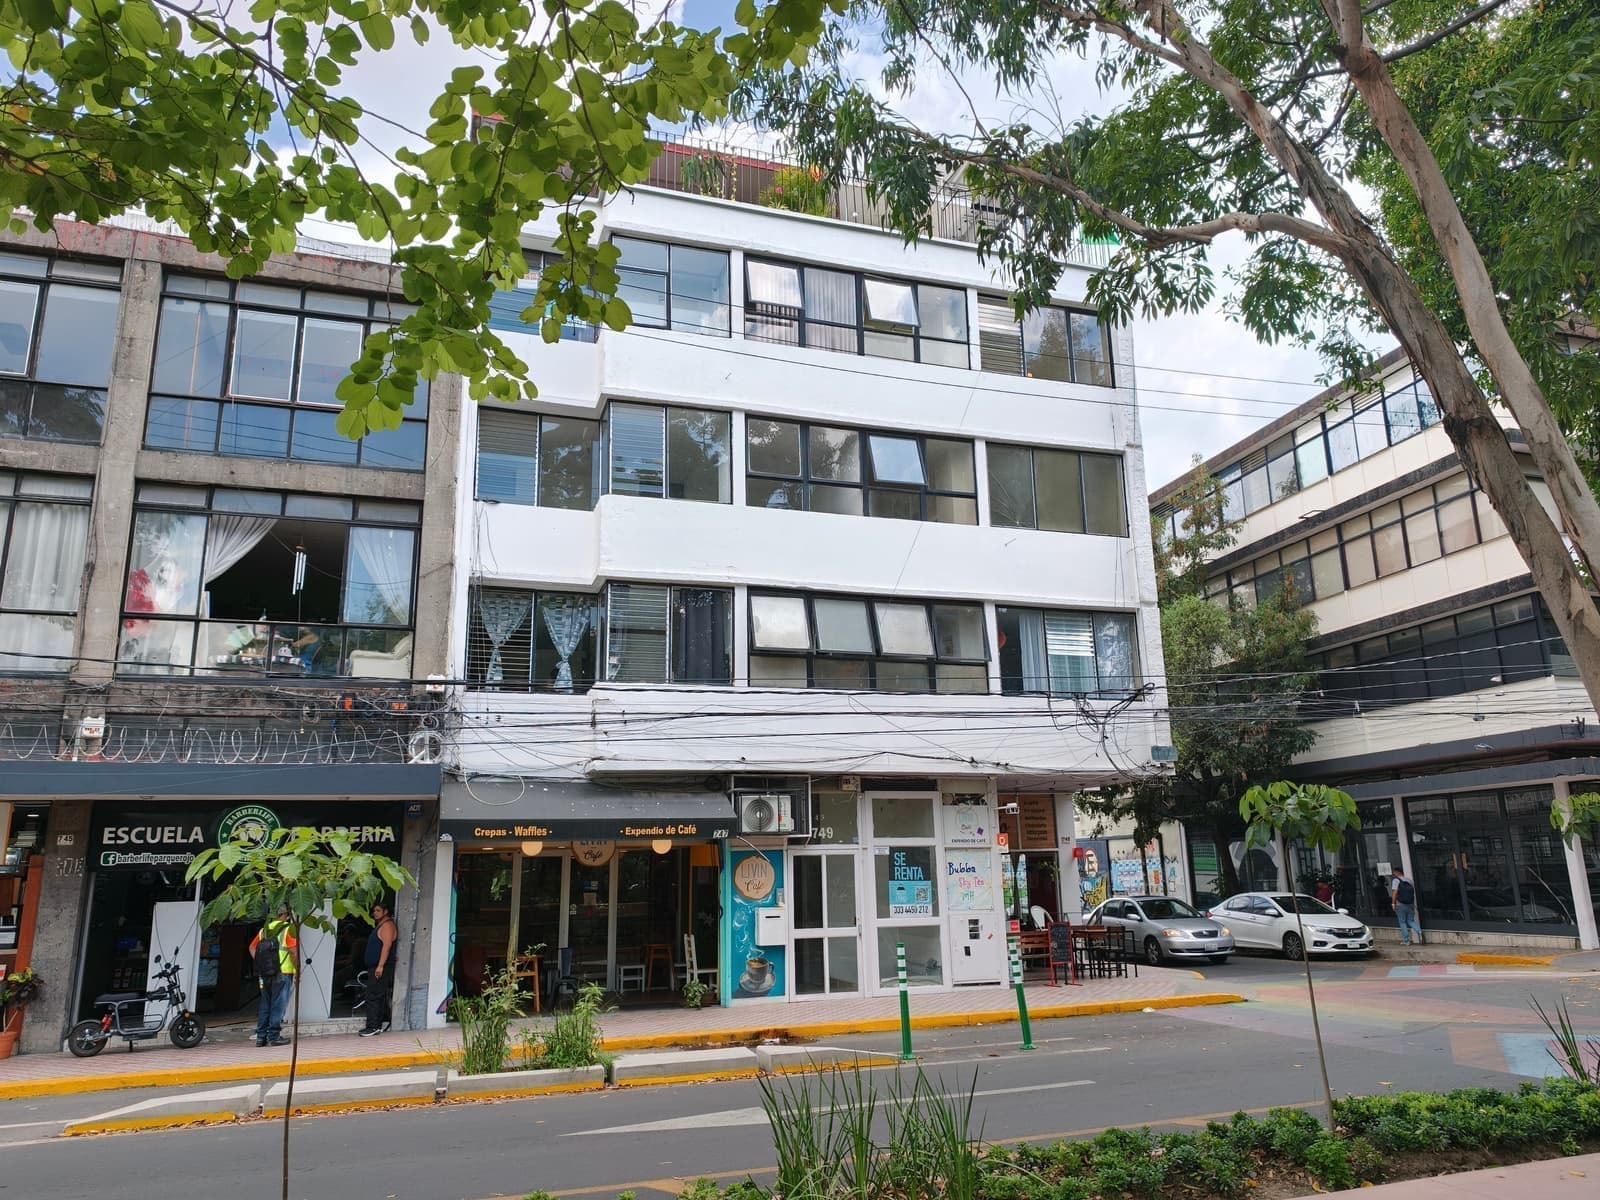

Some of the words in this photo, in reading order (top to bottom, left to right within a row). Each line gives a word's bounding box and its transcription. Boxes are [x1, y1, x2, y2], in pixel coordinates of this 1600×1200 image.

[225, 807, 275, 826] BARBERLIFE
[102, 826, 204, 844] ESCUELA
[290, 826, 395, 842] RERIA
[474, 827, 507, 838] Crepas
[514, 826, 547, 837] Waffles
[625, 826, 664, 837] Expendio
[665, 825, 676, 835] de
[677, 824, 697, 835] Café
[811, 826, 834, 839] 749
[117, 852, 195, 865] barberlifeparquerojo
[894, 851, 906, 866] SE
[741, 862, 768, 878] LIVIN
[894, 866, 924, 880] RENTA
[947, 862, 976, 875] Bubba
